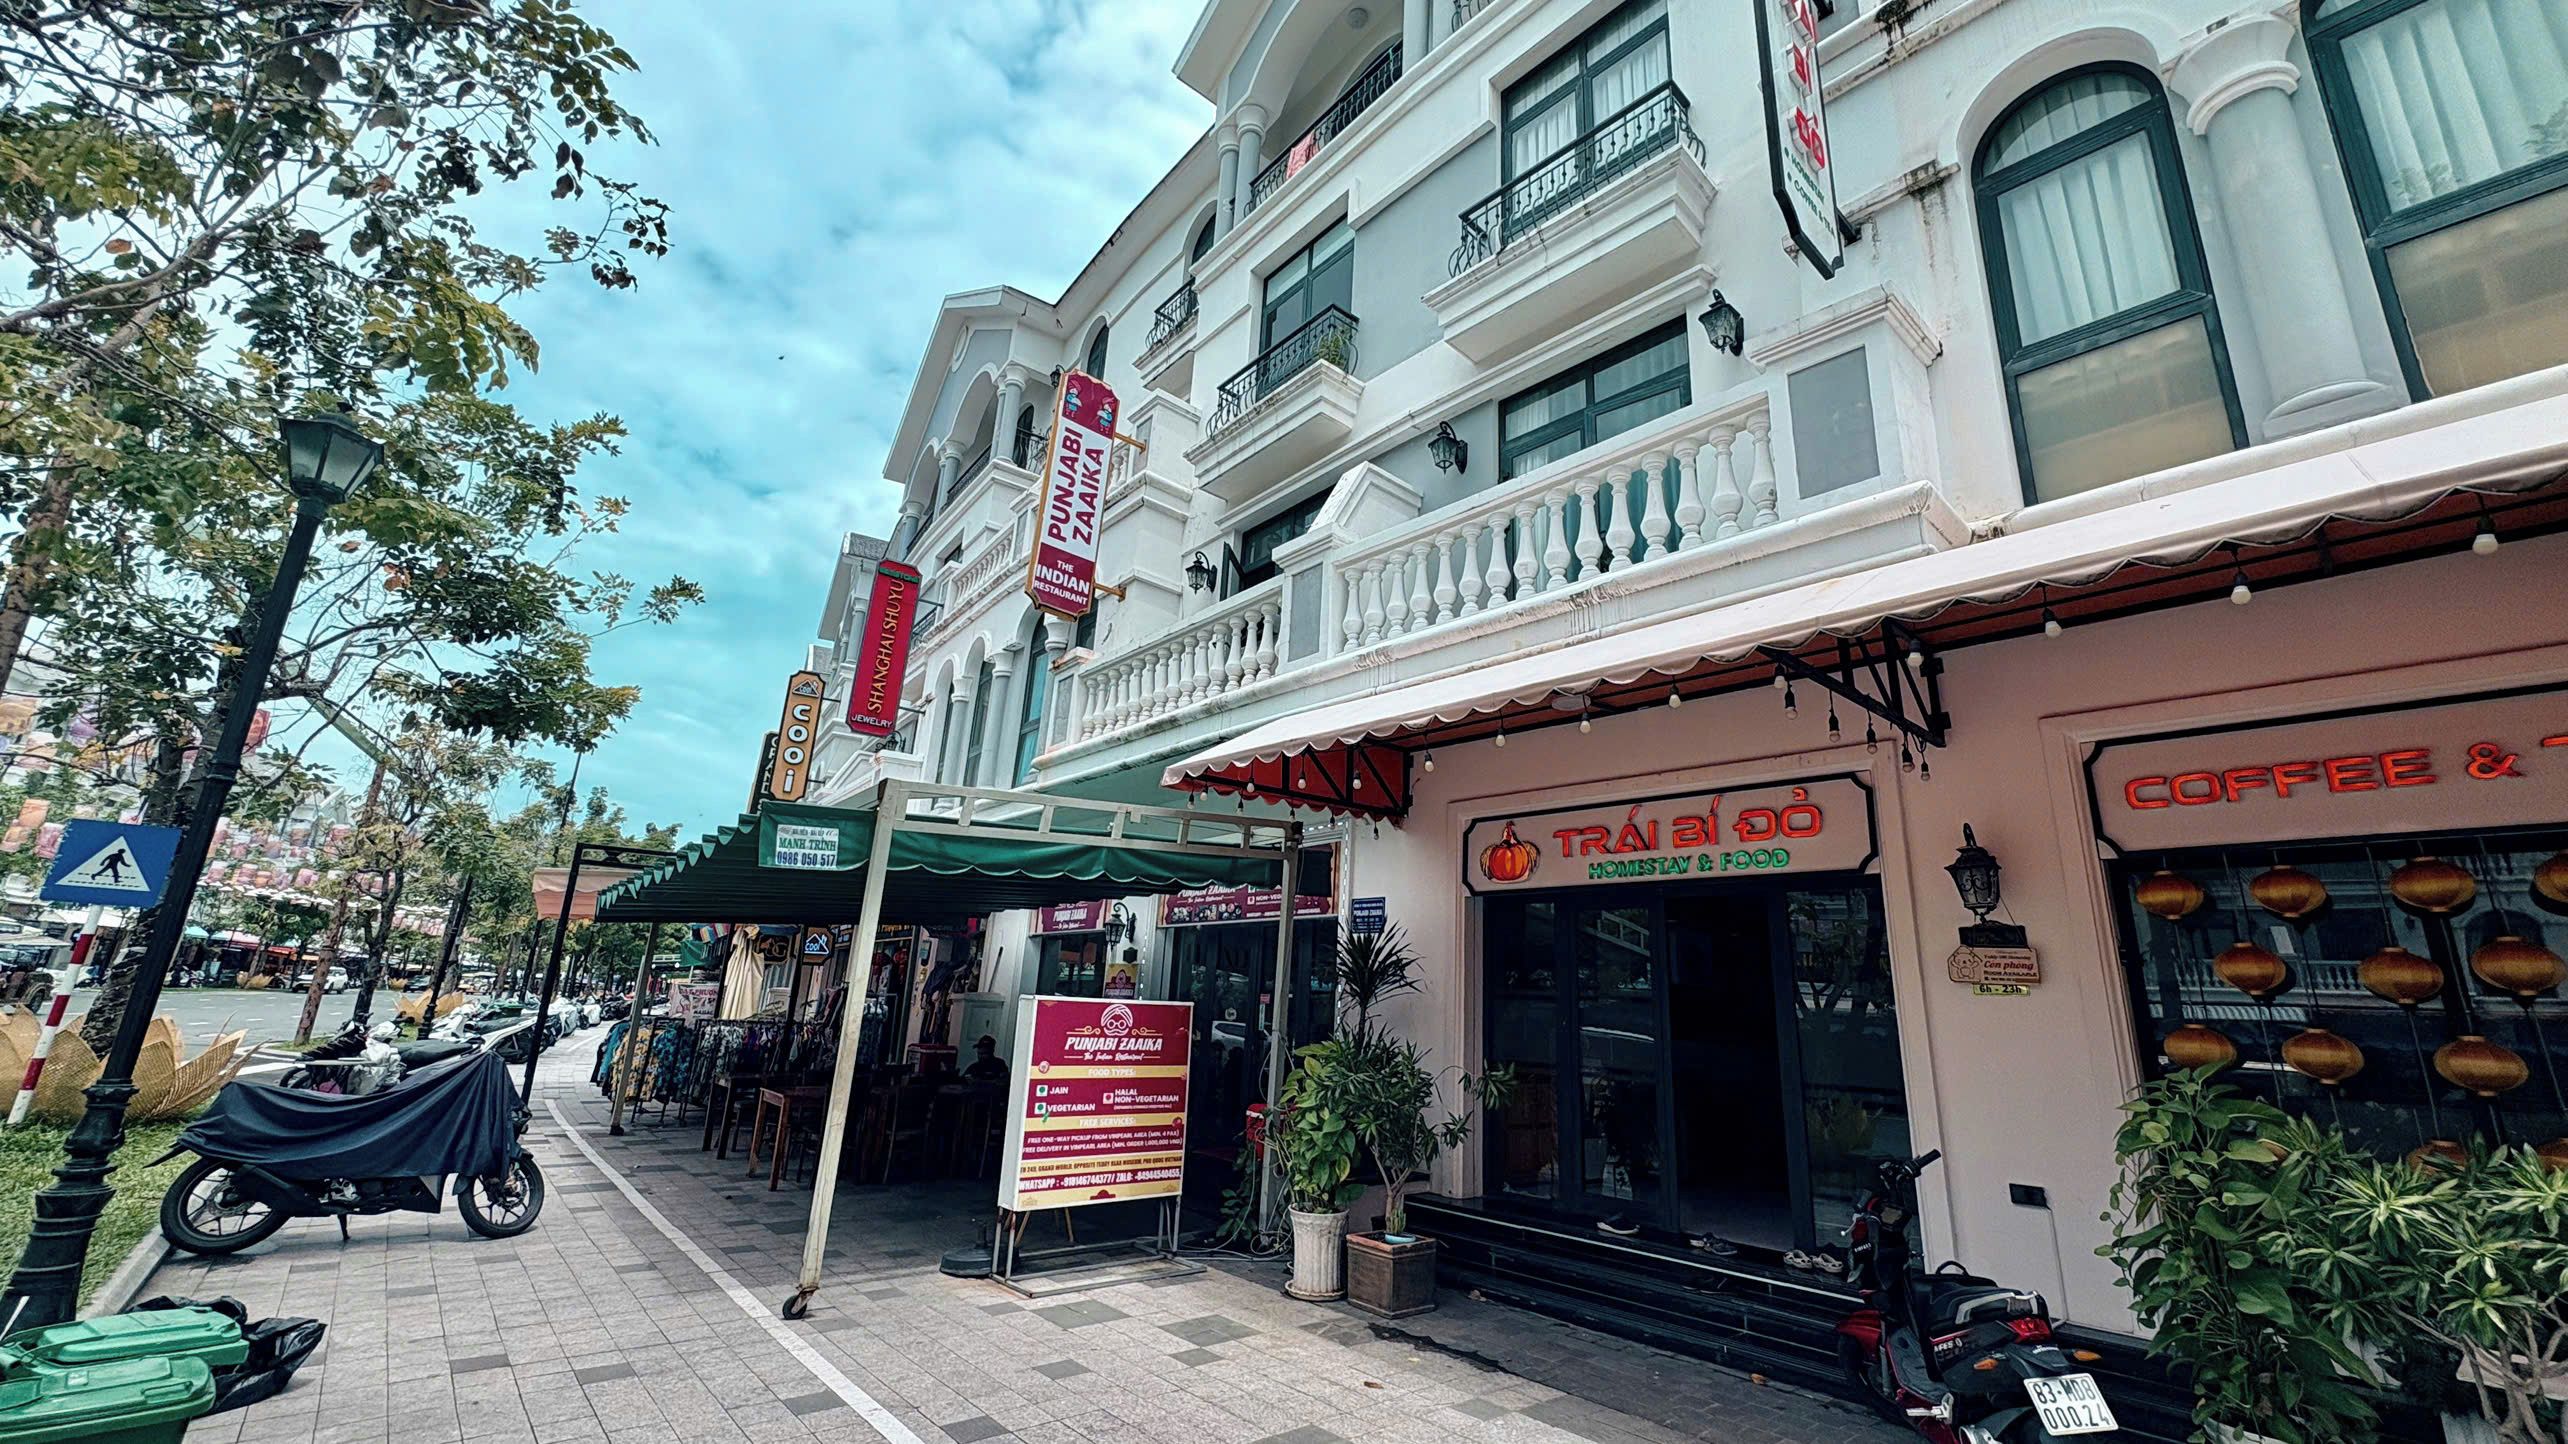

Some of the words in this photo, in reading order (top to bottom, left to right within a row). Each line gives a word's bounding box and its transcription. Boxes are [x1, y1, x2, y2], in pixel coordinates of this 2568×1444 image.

[1047, 427, 1083, 543] PUNJABI
[1072, 448, 1104, 545] ZAAIKA
[1056, 560, 1074, 573] THE
[1036, 564, 1090, 595] INDIAN
[1035, 580, 1088, 605] RESTAURANT
[867, 633, 898, 714] SHANGHAI
[883, 579, 905, 631] SHUYU
[851, 714, 892, 728] JEWELRY
[2124, 747, 2438, 810] COFFEE
[2466, 742, 2524, 780] &
[1552, 804, 1659, 858] TRÁI
[1672, 794, 1723, 848] BÍ
[1733, 786, 1823, 842] ĐỎ
[777, 851, 799, 865] 0986
[801, 852, 818, 866] 050
[820, 853, 835, 866] 517
[1588, 856, 1692, 880] HOMESTAY
[1697, 854, 1714, 873] &
[1719, 848, 1790, 872] FOOD
[1979, 984, 1992, 993] 6h
[2002, 984, 2022, 993] 23h
[1064, 1037, 1118, 1052] PUNJABI
[1118, 1038, 1163, 1051] ZAAIKA
[1088, 1068, 1111, 1076] FOOD
[1114, 1095, 1179, 1103] NON-VEGETARIAN
[1047, 1103, 1096, 1112] VEGETARIAN
[1080, 1118, 1099, 1127] FREE
[1019, 1178, 1056, 1190] WHATSAPP
